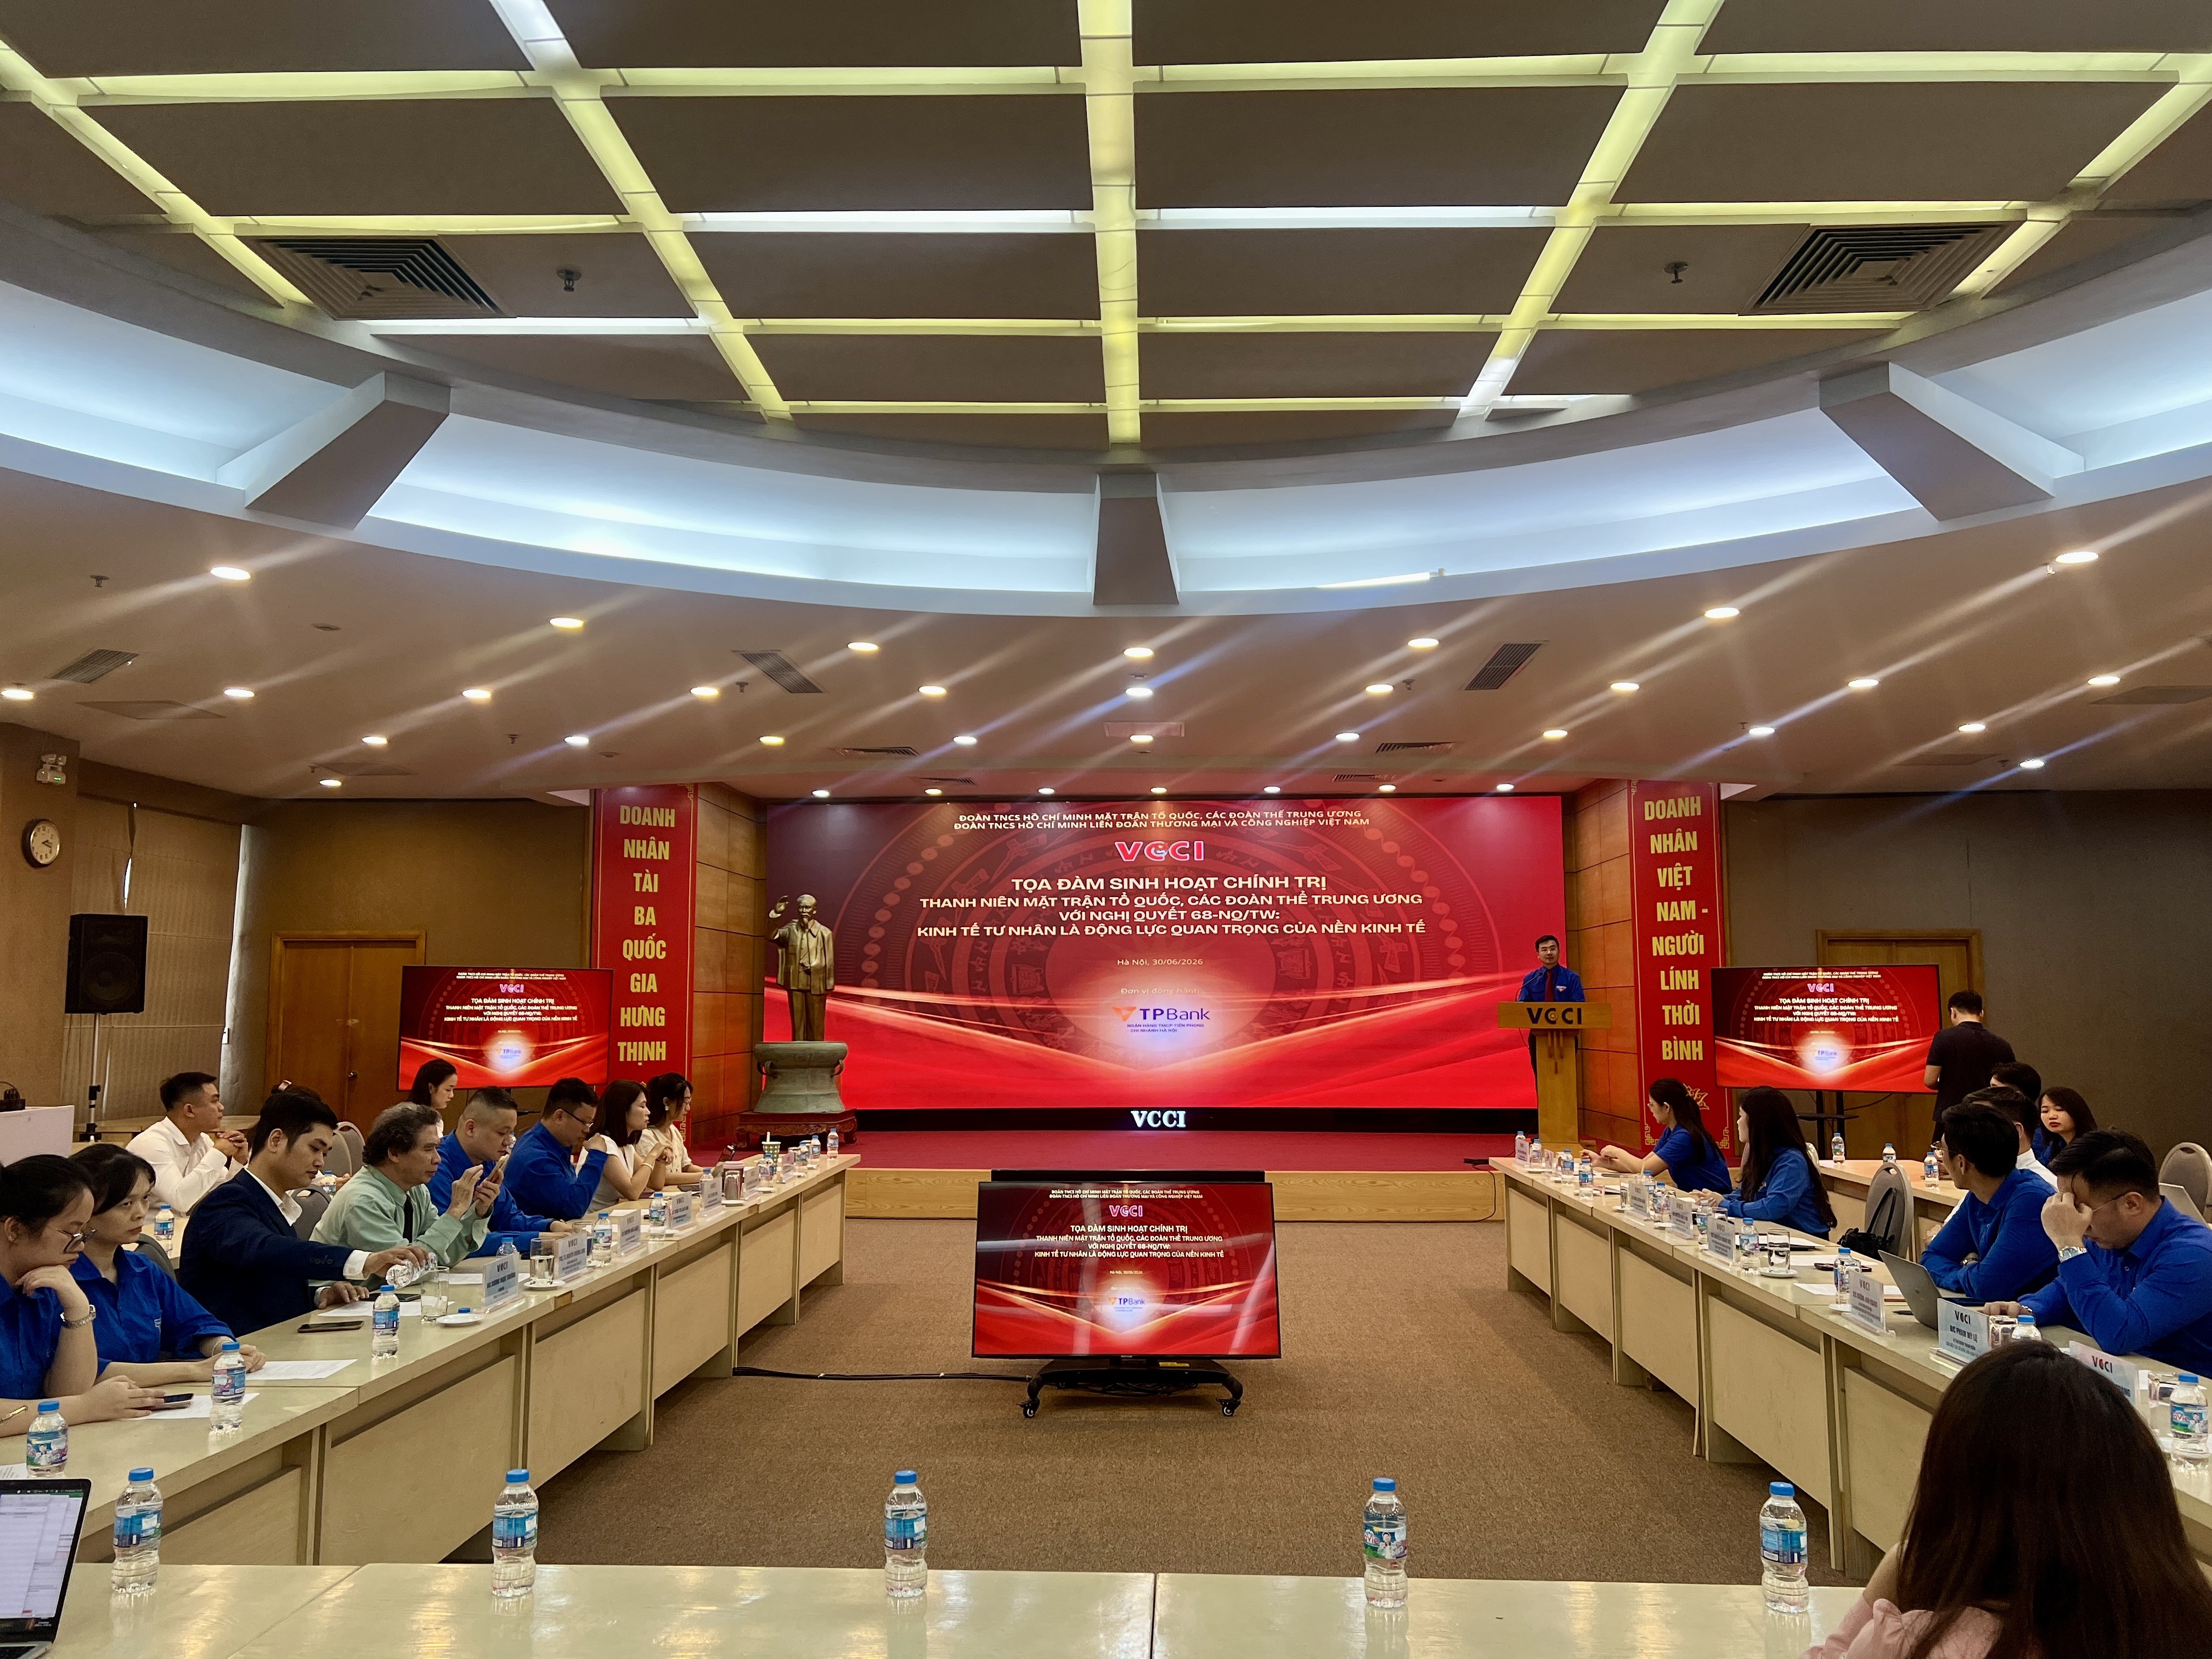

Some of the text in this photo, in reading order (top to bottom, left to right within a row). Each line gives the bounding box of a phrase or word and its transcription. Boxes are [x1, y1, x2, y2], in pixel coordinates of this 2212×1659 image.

[620, 805, 675, 827] DOANH
[1023, 812, 1039, 821] HỒ
[1095, 812, 1118, 821] MẶT
[1120, 812, 1148, 821] TRẬN
[1151, 811, 1166, 819] TỔ
[1169, 810, 1202, 821] QUỐC,
[1263, 809, 1283, 818] THỂ
[1644, 796, 1701, 821] DOANH
[953, 821, 985, 830] ĐOÀN
[1018, 820, 1034, 828] HỒ
[1090, 820, 1113, 828] LIÊN
[1241, 818, 1272, 826] CÔNG
[1275, 818, 1314, 827] NGHIỆP
[1318, 817, 1340, 827] VIỆT
[624, 837, 669, 860] NHÂN
[1115, 841, 1204, 861] VCCI
[1650, 828, 1697, 854] NHÂN
[633, 869, 658, 893] TÀI
[1011, 874, 1325, 893] TỌA ĐÀM SINH HOẠT CHÍNH TRỊ
[1657, 862, 1692, 890] VIỆT
[919, 891, 1422, 909] THANH NIÊN MẶT TRẬN TỔ QUỐC, CÁC ĐOÀN THỂ TRUNG ƯƠNG
[634, 906, 656, 926] BA
[1059, 907, 1279, 922] VỚI NGHỊ QUYẾT 68-NQ/TW:
[1656, 900, 1696, 922] NAM
[918, 920, 1425, 937] KINH TẾ TƯ NHÂN LÀ ĐỘNG LỰC QUAN TRỌNG CỦA NỀN KINH TẾ
[623, 933, 666, 960] QUỐC
[1652, 930, 1704, 956] NGƯỜI
[630, 973, 657, 992] GIA
[1660, 966, 1699, 991] LÍNH
[620, 1005, 665, 1026] HƯNG
[1139, 1008, 1210, 1020] TPBank
[1526, 1008, 1582, 1024] VCCI
[1662, 1000, 1700, 1025] THỜI
[618, 1041, 666, 1065] THỊNH
[1662, 1035, 1703, 1061] BÌNH
[1131, 1110, 1186, 1127] VCCI
[1109, 1205, 1143, 1217] VCCI
[1087, 1224, 1105, 1232] ĐÀM
[1149, 1224, 1173, 1232] CHÍNH
